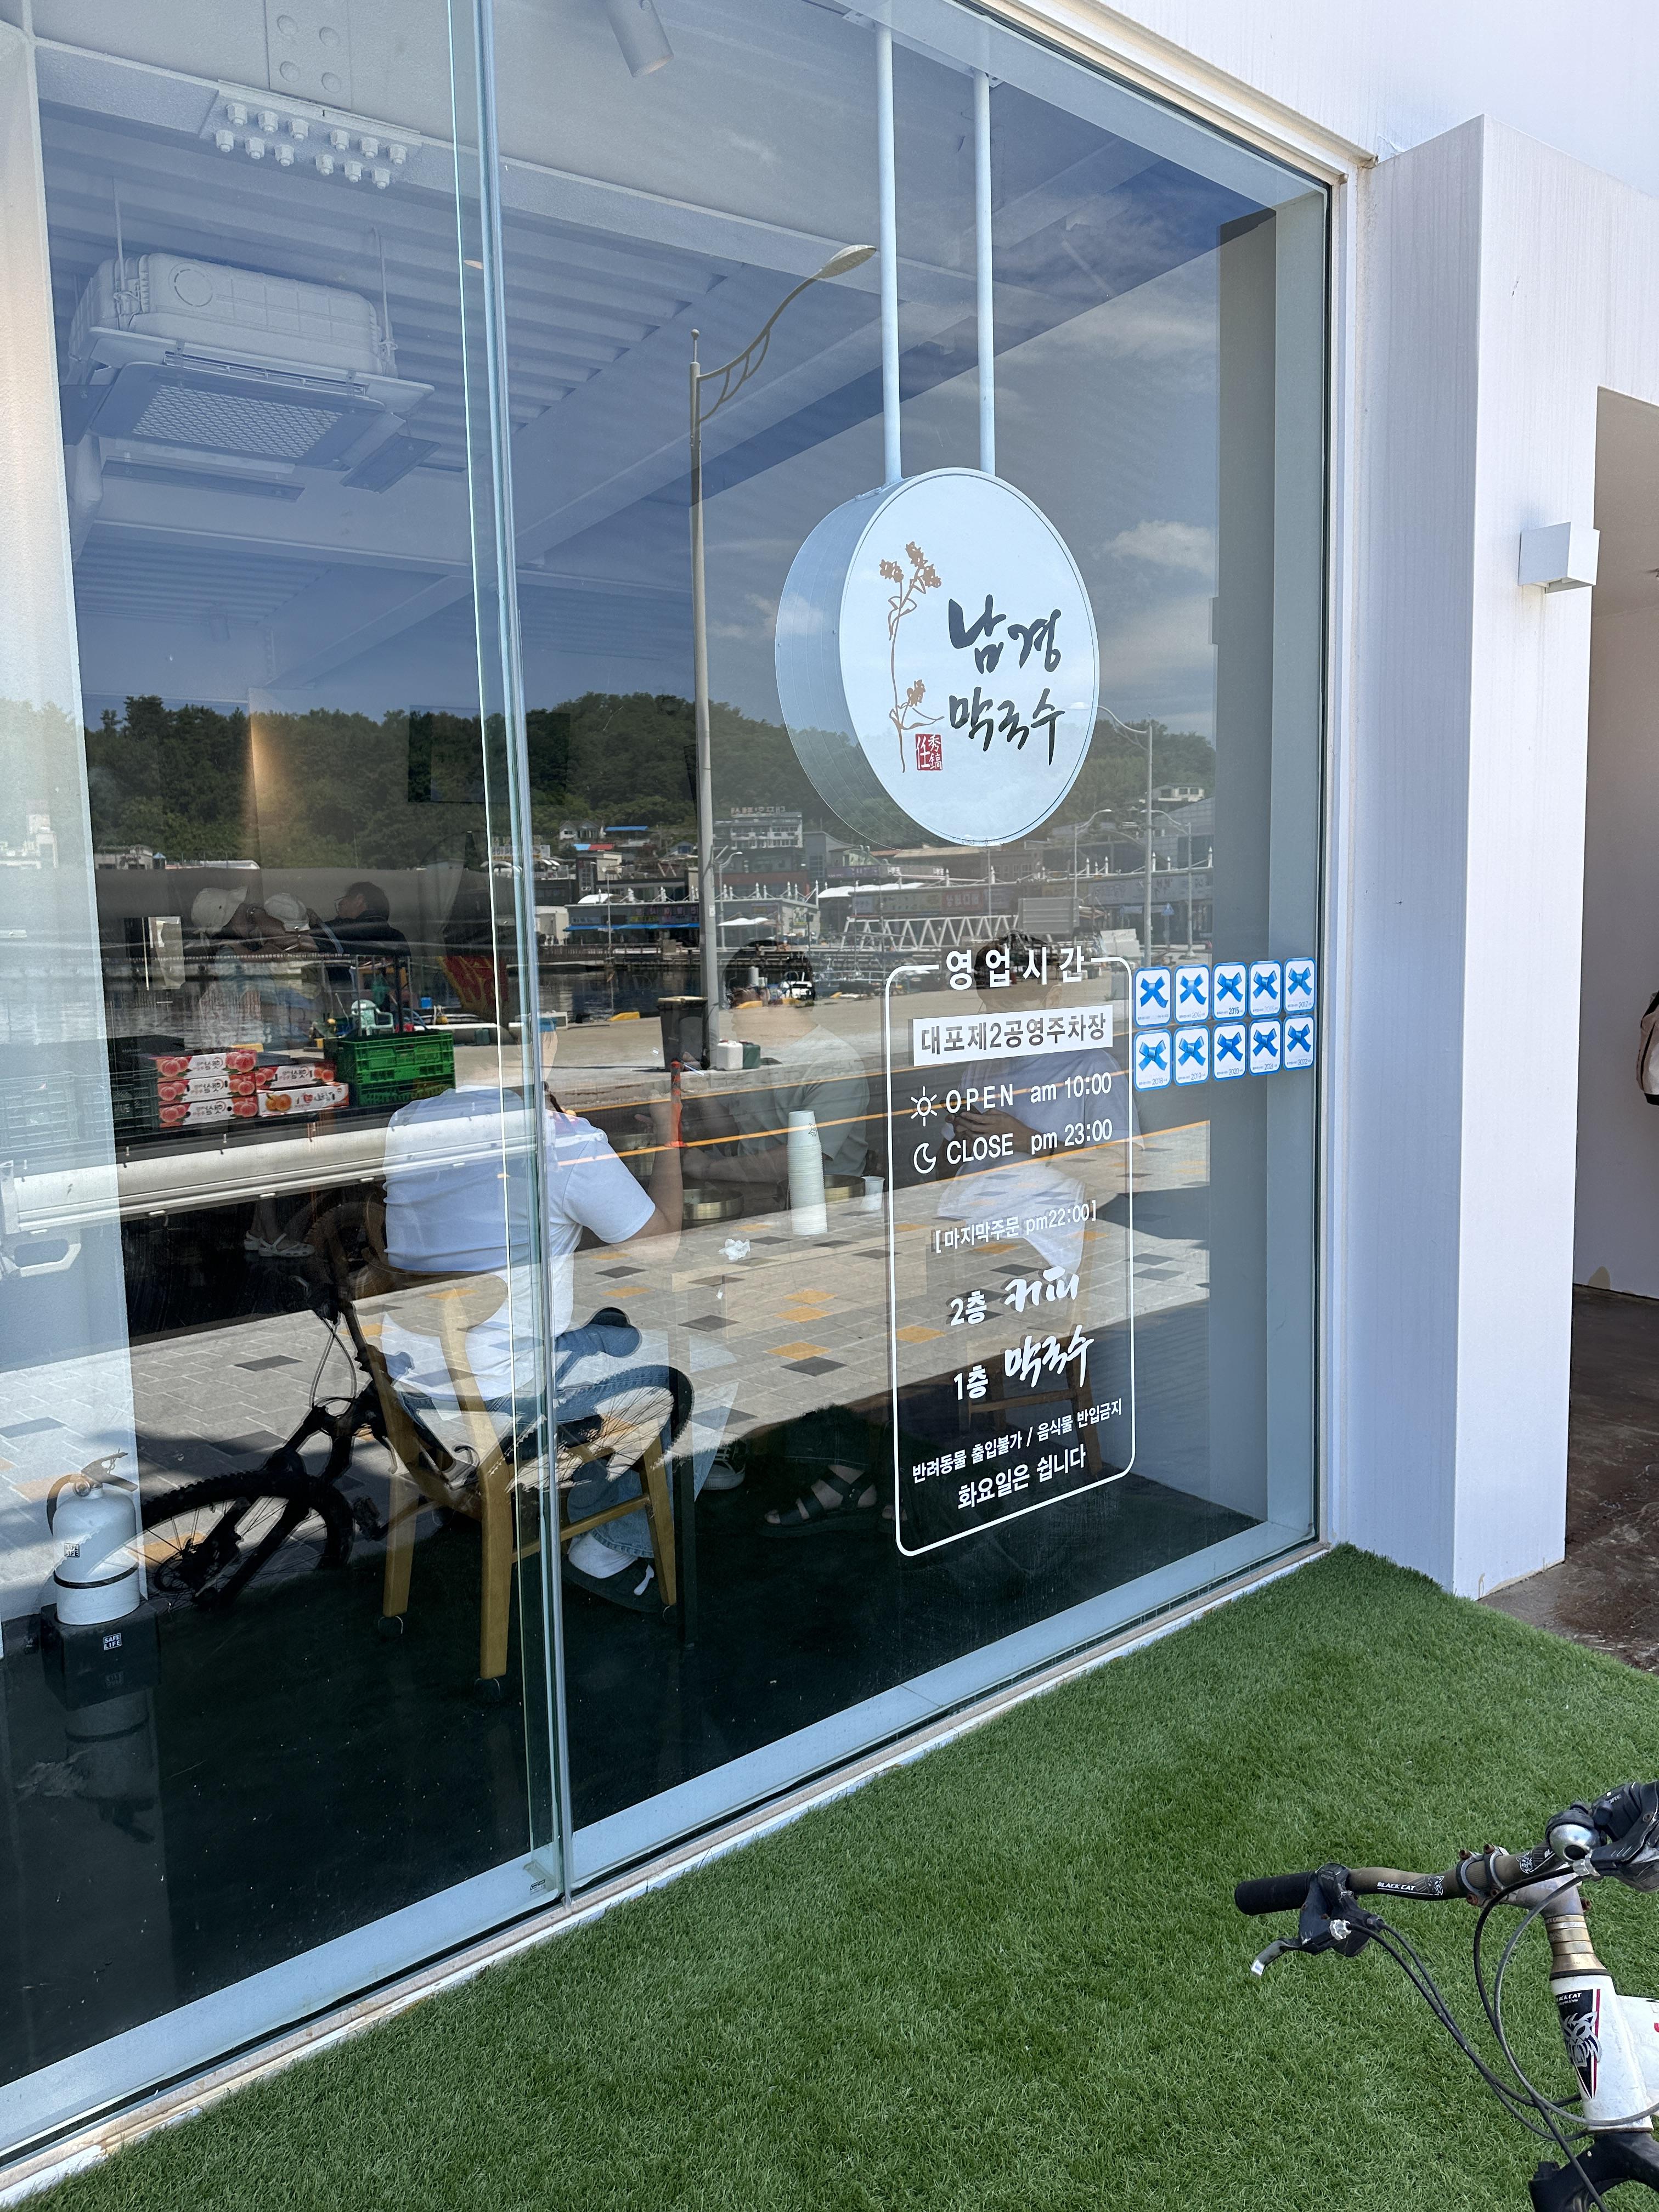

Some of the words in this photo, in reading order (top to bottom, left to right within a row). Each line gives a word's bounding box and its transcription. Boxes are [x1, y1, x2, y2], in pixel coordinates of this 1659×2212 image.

[948, 594, 1062, 674] 남경
[949, 687, 1065, 766] 막국수
[945, 945, 1085, 991] 영업시간
[921, 1012, 1107, 1056] 대포제2공영주차장
[945, 1084, 1014, 1115] OPEN
[1030, 1085, 1057, 1104] am
[1065, 1071, 1112, 1099] 10:00
[1152, 1077, 1164, 1085] 2018
[1190, 1072, 1201, 1080] 2019
[946, 1133, 1014, 1164] CLOSE
[1030, 1131, 1058, 1154] pm
[1064, 1118, 1113, 1146] 23:00
[935, 1219, 1020, 1254] [마지막주문
[1026, 1199, 1097, 1236] pm22:00]
[950, 1291, 987, 1327] 2층
[953, 1364, 989, 1401] 1층
[1004, 1324, 1095, 1388] 막국수
[912, 1450, 967, 1483] 반려동물
[970, 1430, 1023, 1464] 출입불가
[1037, 1417, 1073, 1441] 음식물
[1077, 1398, 1123, 1428] 반입금지
[957, 1463, 1029, 1509] 화요일은
[1036, 1443, 1087, 1482] 쉽니다
[104, 1634, 120, 1644] SAFE
[105, 1640, 121, 1649] LIFE
[1377, 1882, 1400, 1891] BLACK
